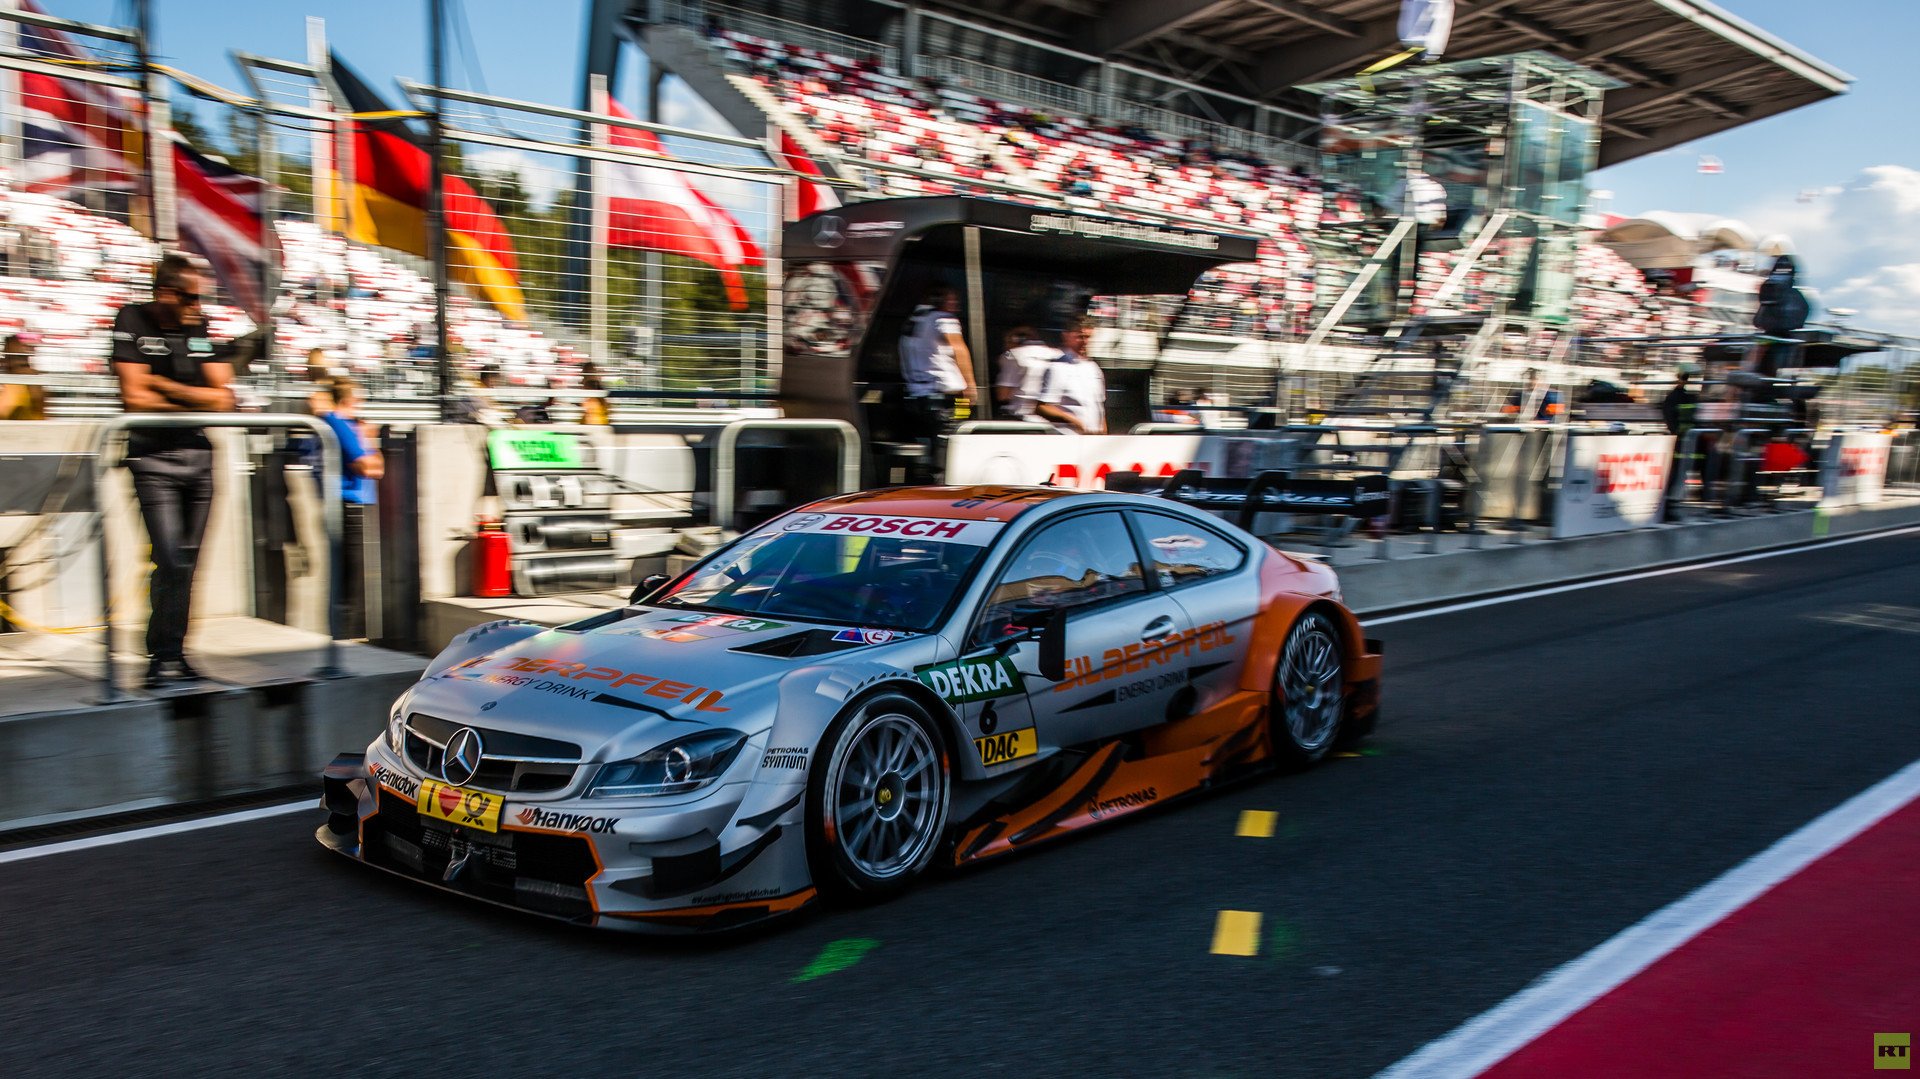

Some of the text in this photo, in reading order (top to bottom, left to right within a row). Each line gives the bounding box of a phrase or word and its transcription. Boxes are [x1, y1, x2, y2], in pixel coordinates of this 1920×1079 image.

[820, 517, 970, 538] BOSCH
[679, 614, 766, 631] DRA
[1052, 620, 1237, 693] SILBERPFEIL
[534, 681, 597, 700] DRINK
[929, 660, 1013, 698] DEKRA
[979, 700, 998, 734] 6
[766, 747, 809, 755] PETRONAS
[1099, 786, 1158, 814] PETRONAS
